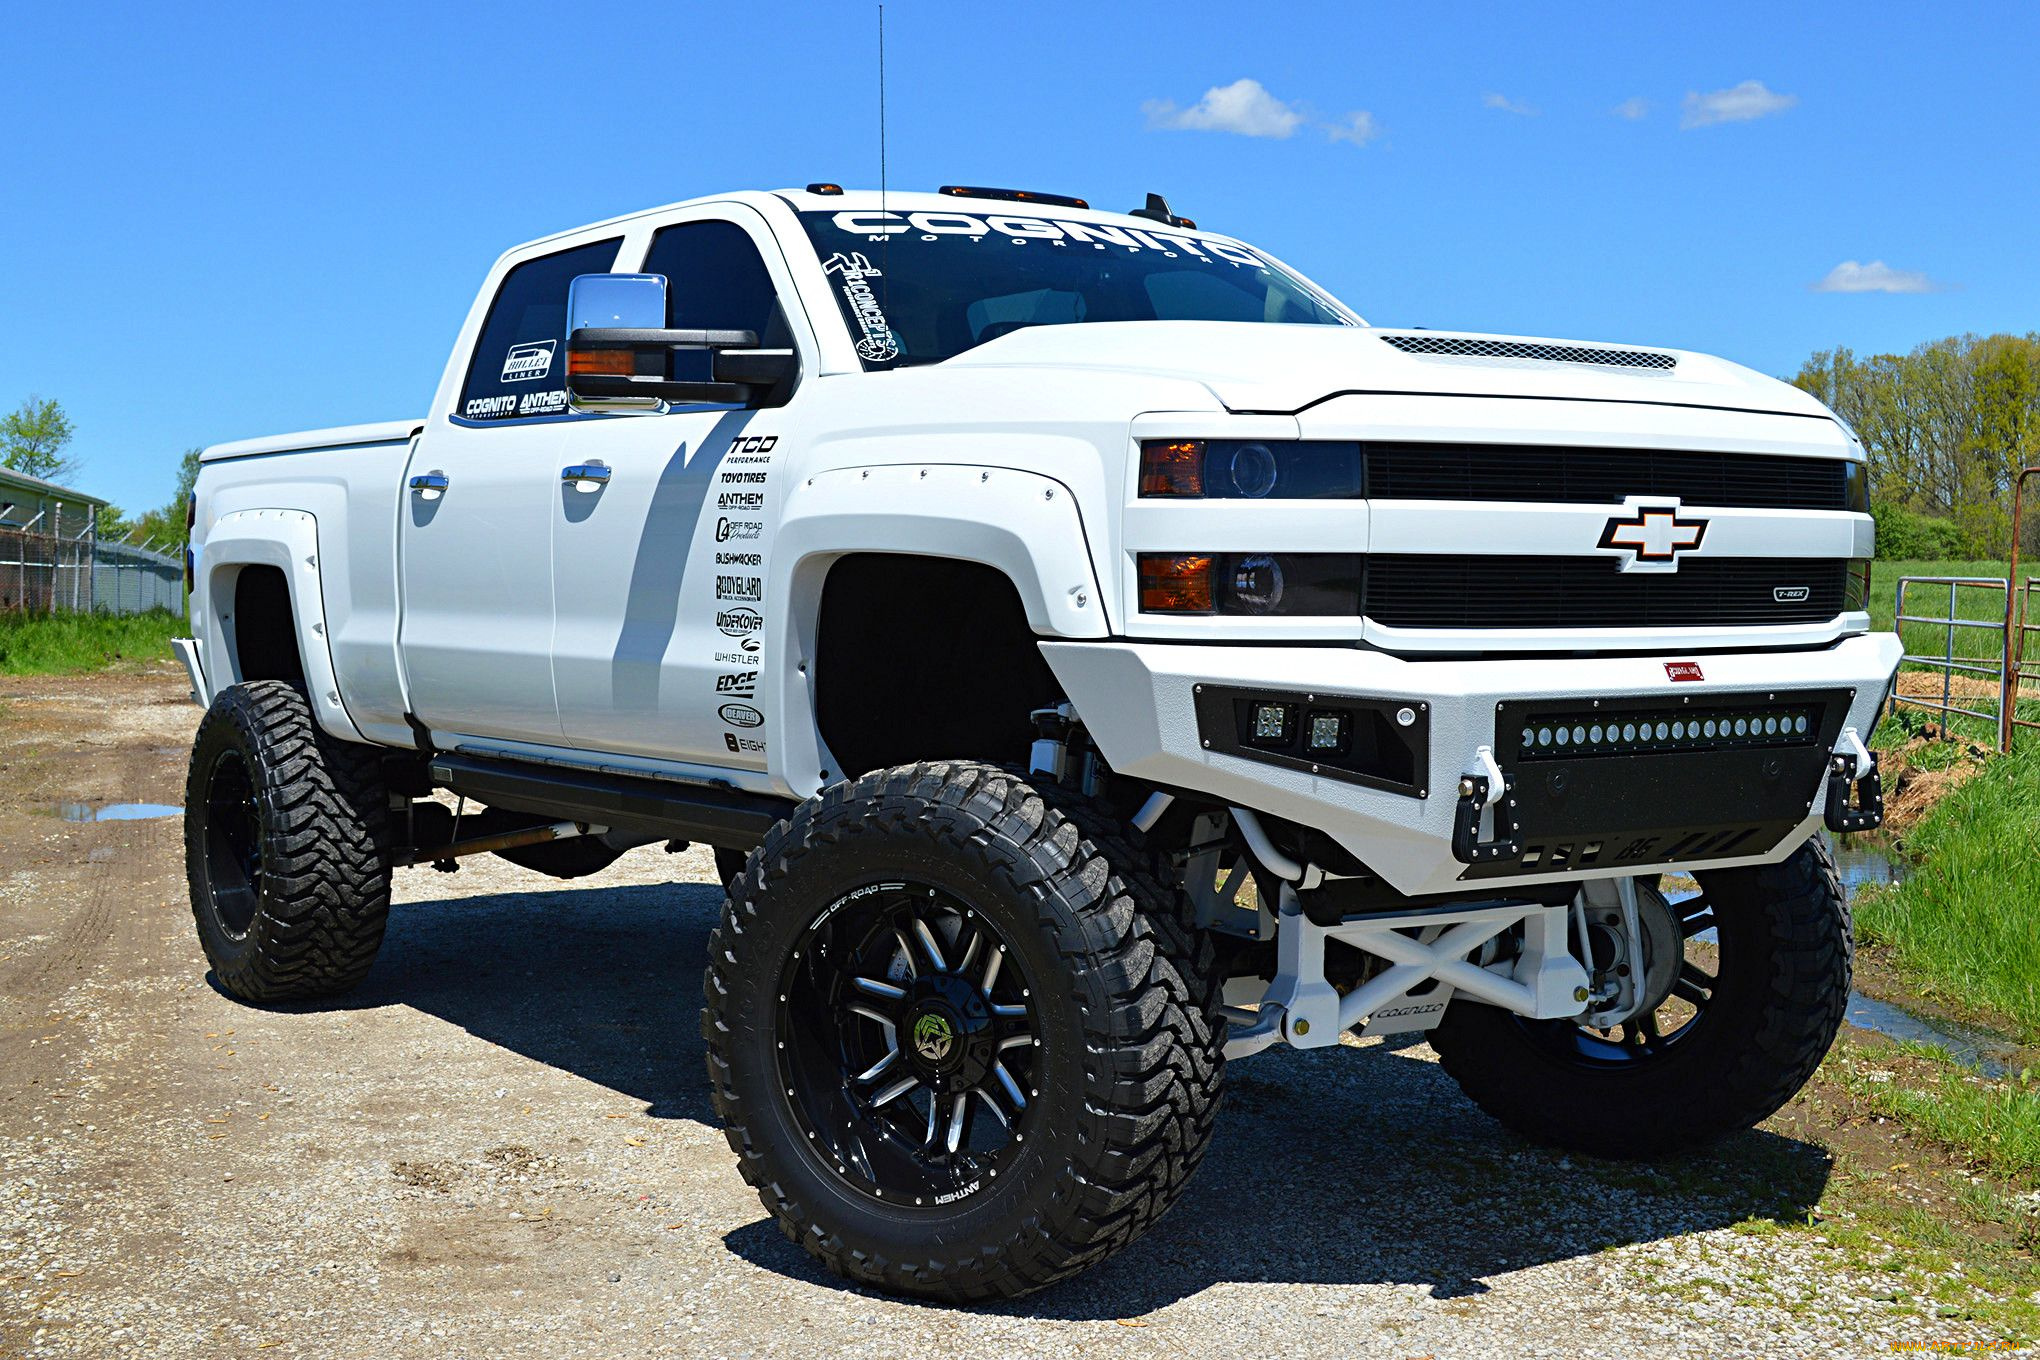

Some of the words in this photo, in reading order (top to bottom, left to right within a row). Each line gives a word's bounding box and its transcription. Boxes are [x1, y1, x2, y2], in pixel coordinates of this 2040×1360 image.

[832, 211, 1266, 268] COGNITO
[508, 357, 548, 370] BULLET
[509, 370, 541, 379] LINER
[466, 395, 517, 414] COGNITO
[520, 390, 567, 409] ANTHEM
[726, 456, 771, 464] PERFORMANCE
[718, 493, 763, 506] ANTHEM
[744, 522, 763, 530] ROAD
[716, 552, 762, 566] BUSHWACKER
[716, 575, 761, 602] BODYGUARD
[1778, 590, 1804, 598] T-REX
[715, 652, 759, 665] WHISTLER
[715, 671, 758, 691] EDGE
[830, 884, 879, 913] OFF-ROAD
[1377, 1003, 1444, 1018] COGNITO
[934, 1180, 980, 1205] ANTHEM
